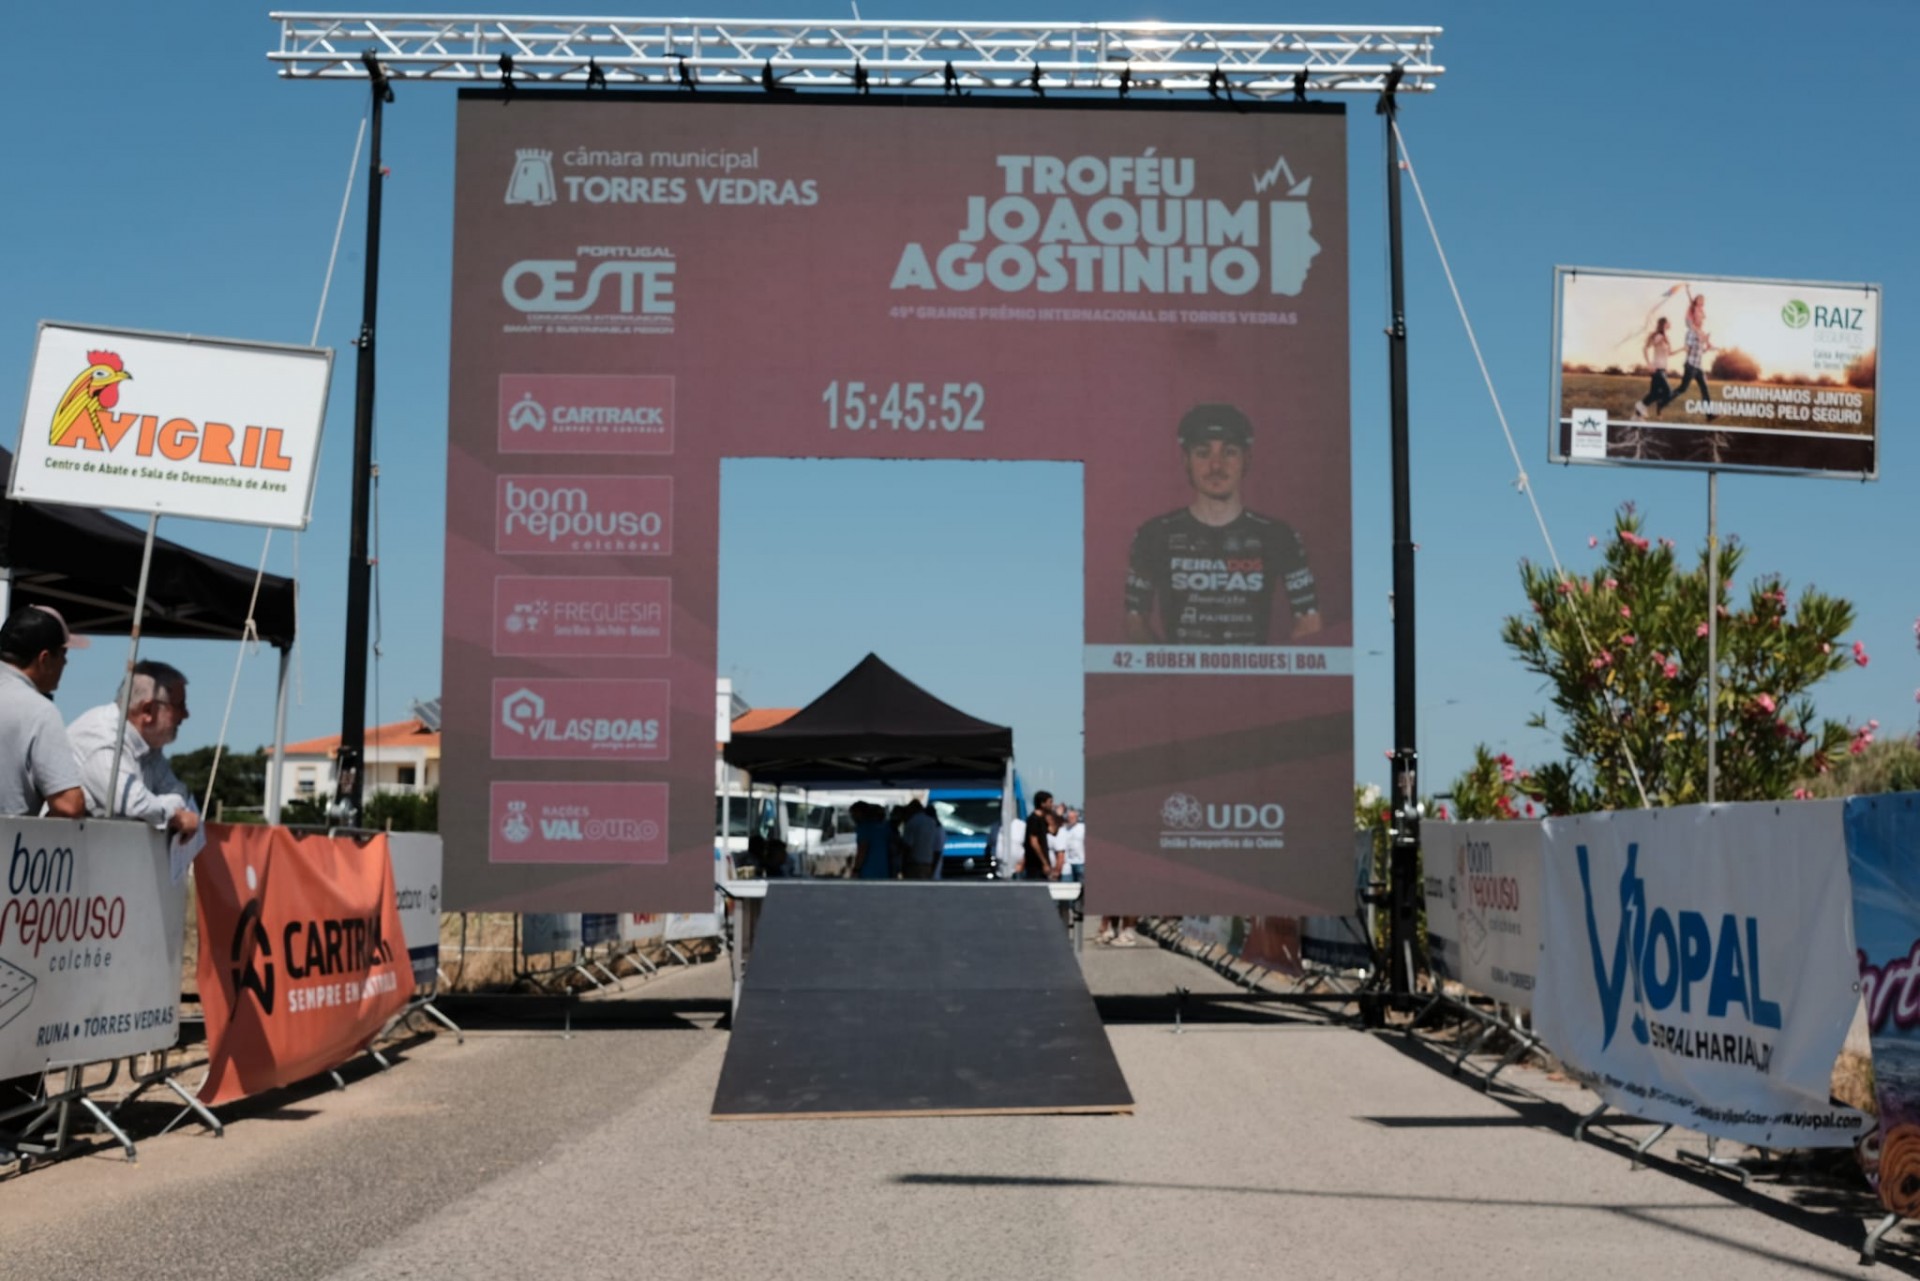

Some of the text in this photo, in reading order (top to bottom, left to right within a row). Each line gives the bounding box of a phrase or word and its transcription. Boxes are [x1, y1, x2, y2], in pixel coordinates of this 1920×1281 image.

[562, 147, 759, 174] câmara municipal
[996, 147, 1195, 197] TROFÉU
[563, 176, 819, 206] TORRES VEDRAS
[958, 195, 1259, 247] JOAQUIM
[576, 246, 676, 258] PORTUGAL
[889, 242, 1261, 296] AGOSTINHO
[916, 307, 976, 320] GRANDE
[978, 305, 1037, 321] PRÉMIO
[1038, 308, 1155, 323] INTERNACIONAL
[1157, 310, 1178, 323] DE
[1179, 310, 1236, 324] TORRES
[1238, 312, 1298, 325] VEDRAS
[1814, 305, 1864, 331] RAIZ
[821, 379, 986, 432] 15:45:52
[1684, 398, 1863, 425] CAMINHAMOS PELO SEGURO
[1722, 385, 1863, 408] CAMINHAMOS JUNTOS
[551, 406, 664, 425] CARTRACK
[54, 406, 293, 472] AVIGRIL
[44, 456, 288, 493] Centro de Abate e Sala de Desmancha de Aves
[505, 481, 589, 512] bom
[505, 511, 663, 542] repouso
[553, 602, 662, 622] FREGUESIA
[1112, 651, 1134, 669] 42
[1145, 647, 1197, 669] RÚBEN
[1295, 653, 1328, 670] BOA
[1206, 803, 1286, 831] UDO
[9, 832, 75, 896] bom
[1466, 831, 1493, 875] bom
[0, 896, 126, 960] repouso
[287, 982, 342, 1014] SEMPRE
[36, 1005, 175, 1048] RUNA TORRES VEDRAS
